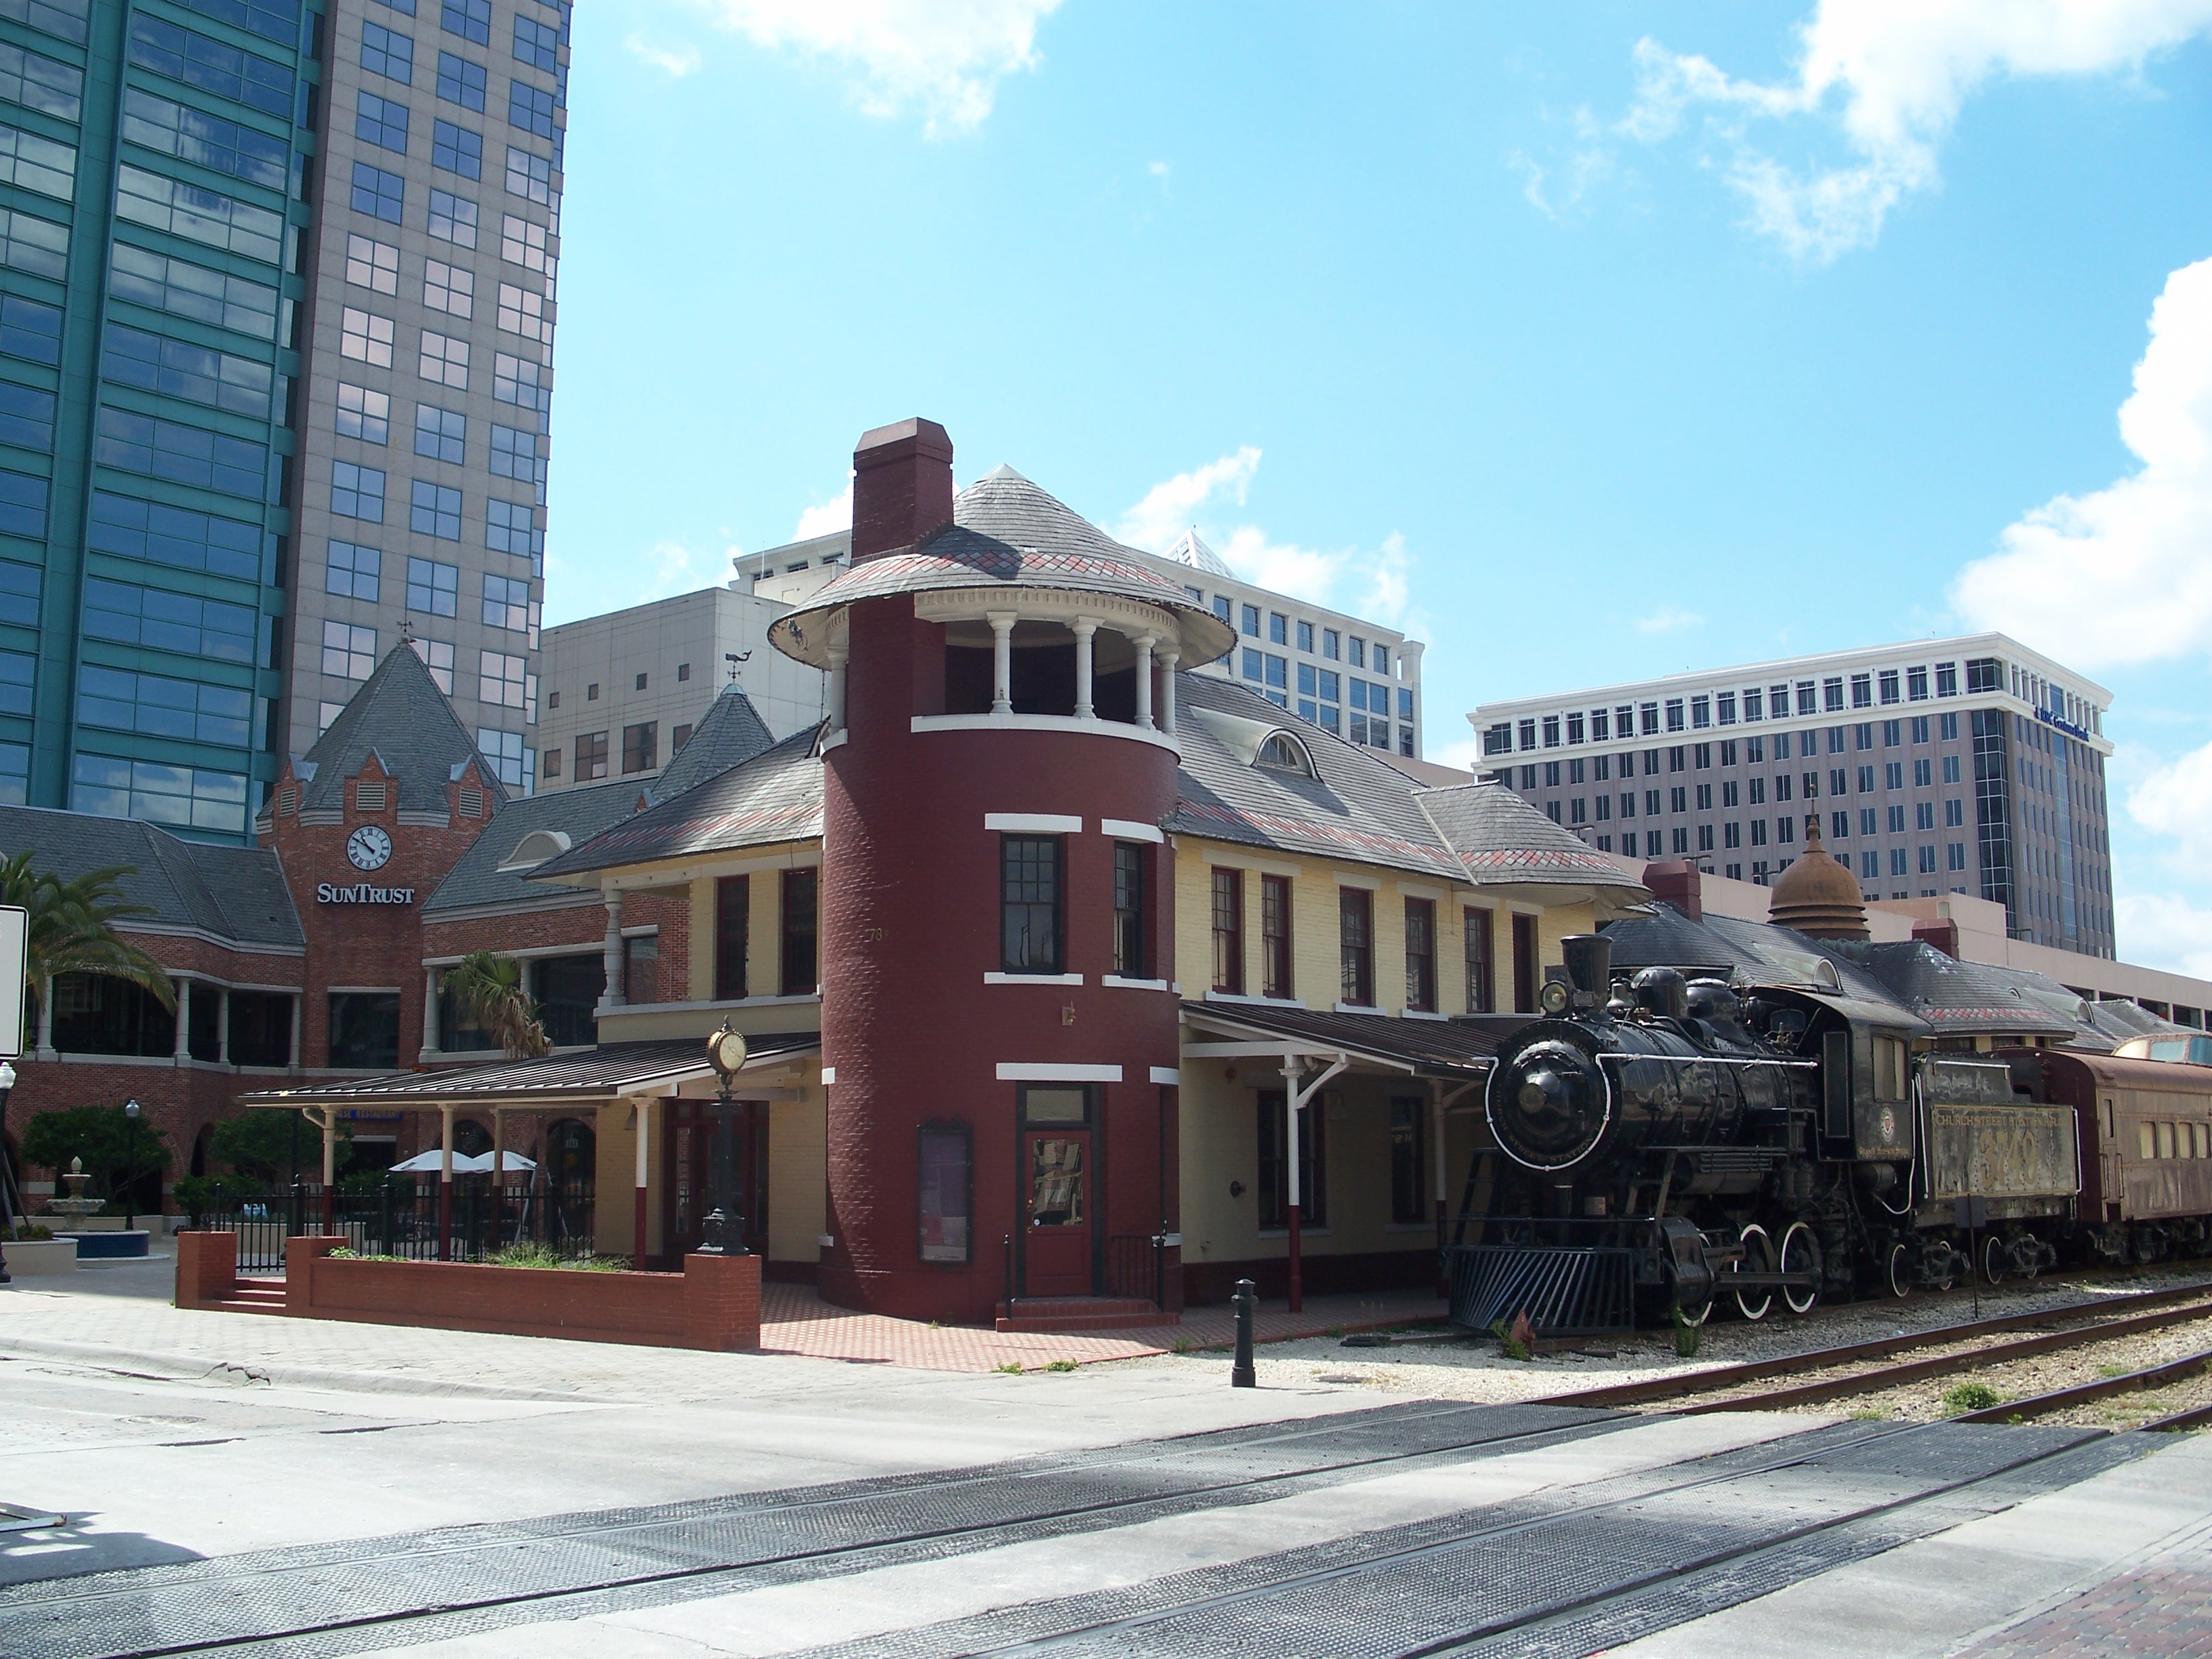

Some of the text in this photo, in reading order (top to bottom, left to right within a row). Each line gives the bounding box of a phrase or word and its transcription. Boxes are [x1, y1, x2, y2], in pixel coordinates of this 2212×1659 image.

[1936, 1115, 1973, 1126] CHURCH
[1975, 1115, 2007, 1126] STREET
[1978, 1129, 2037, 1189] 3749
